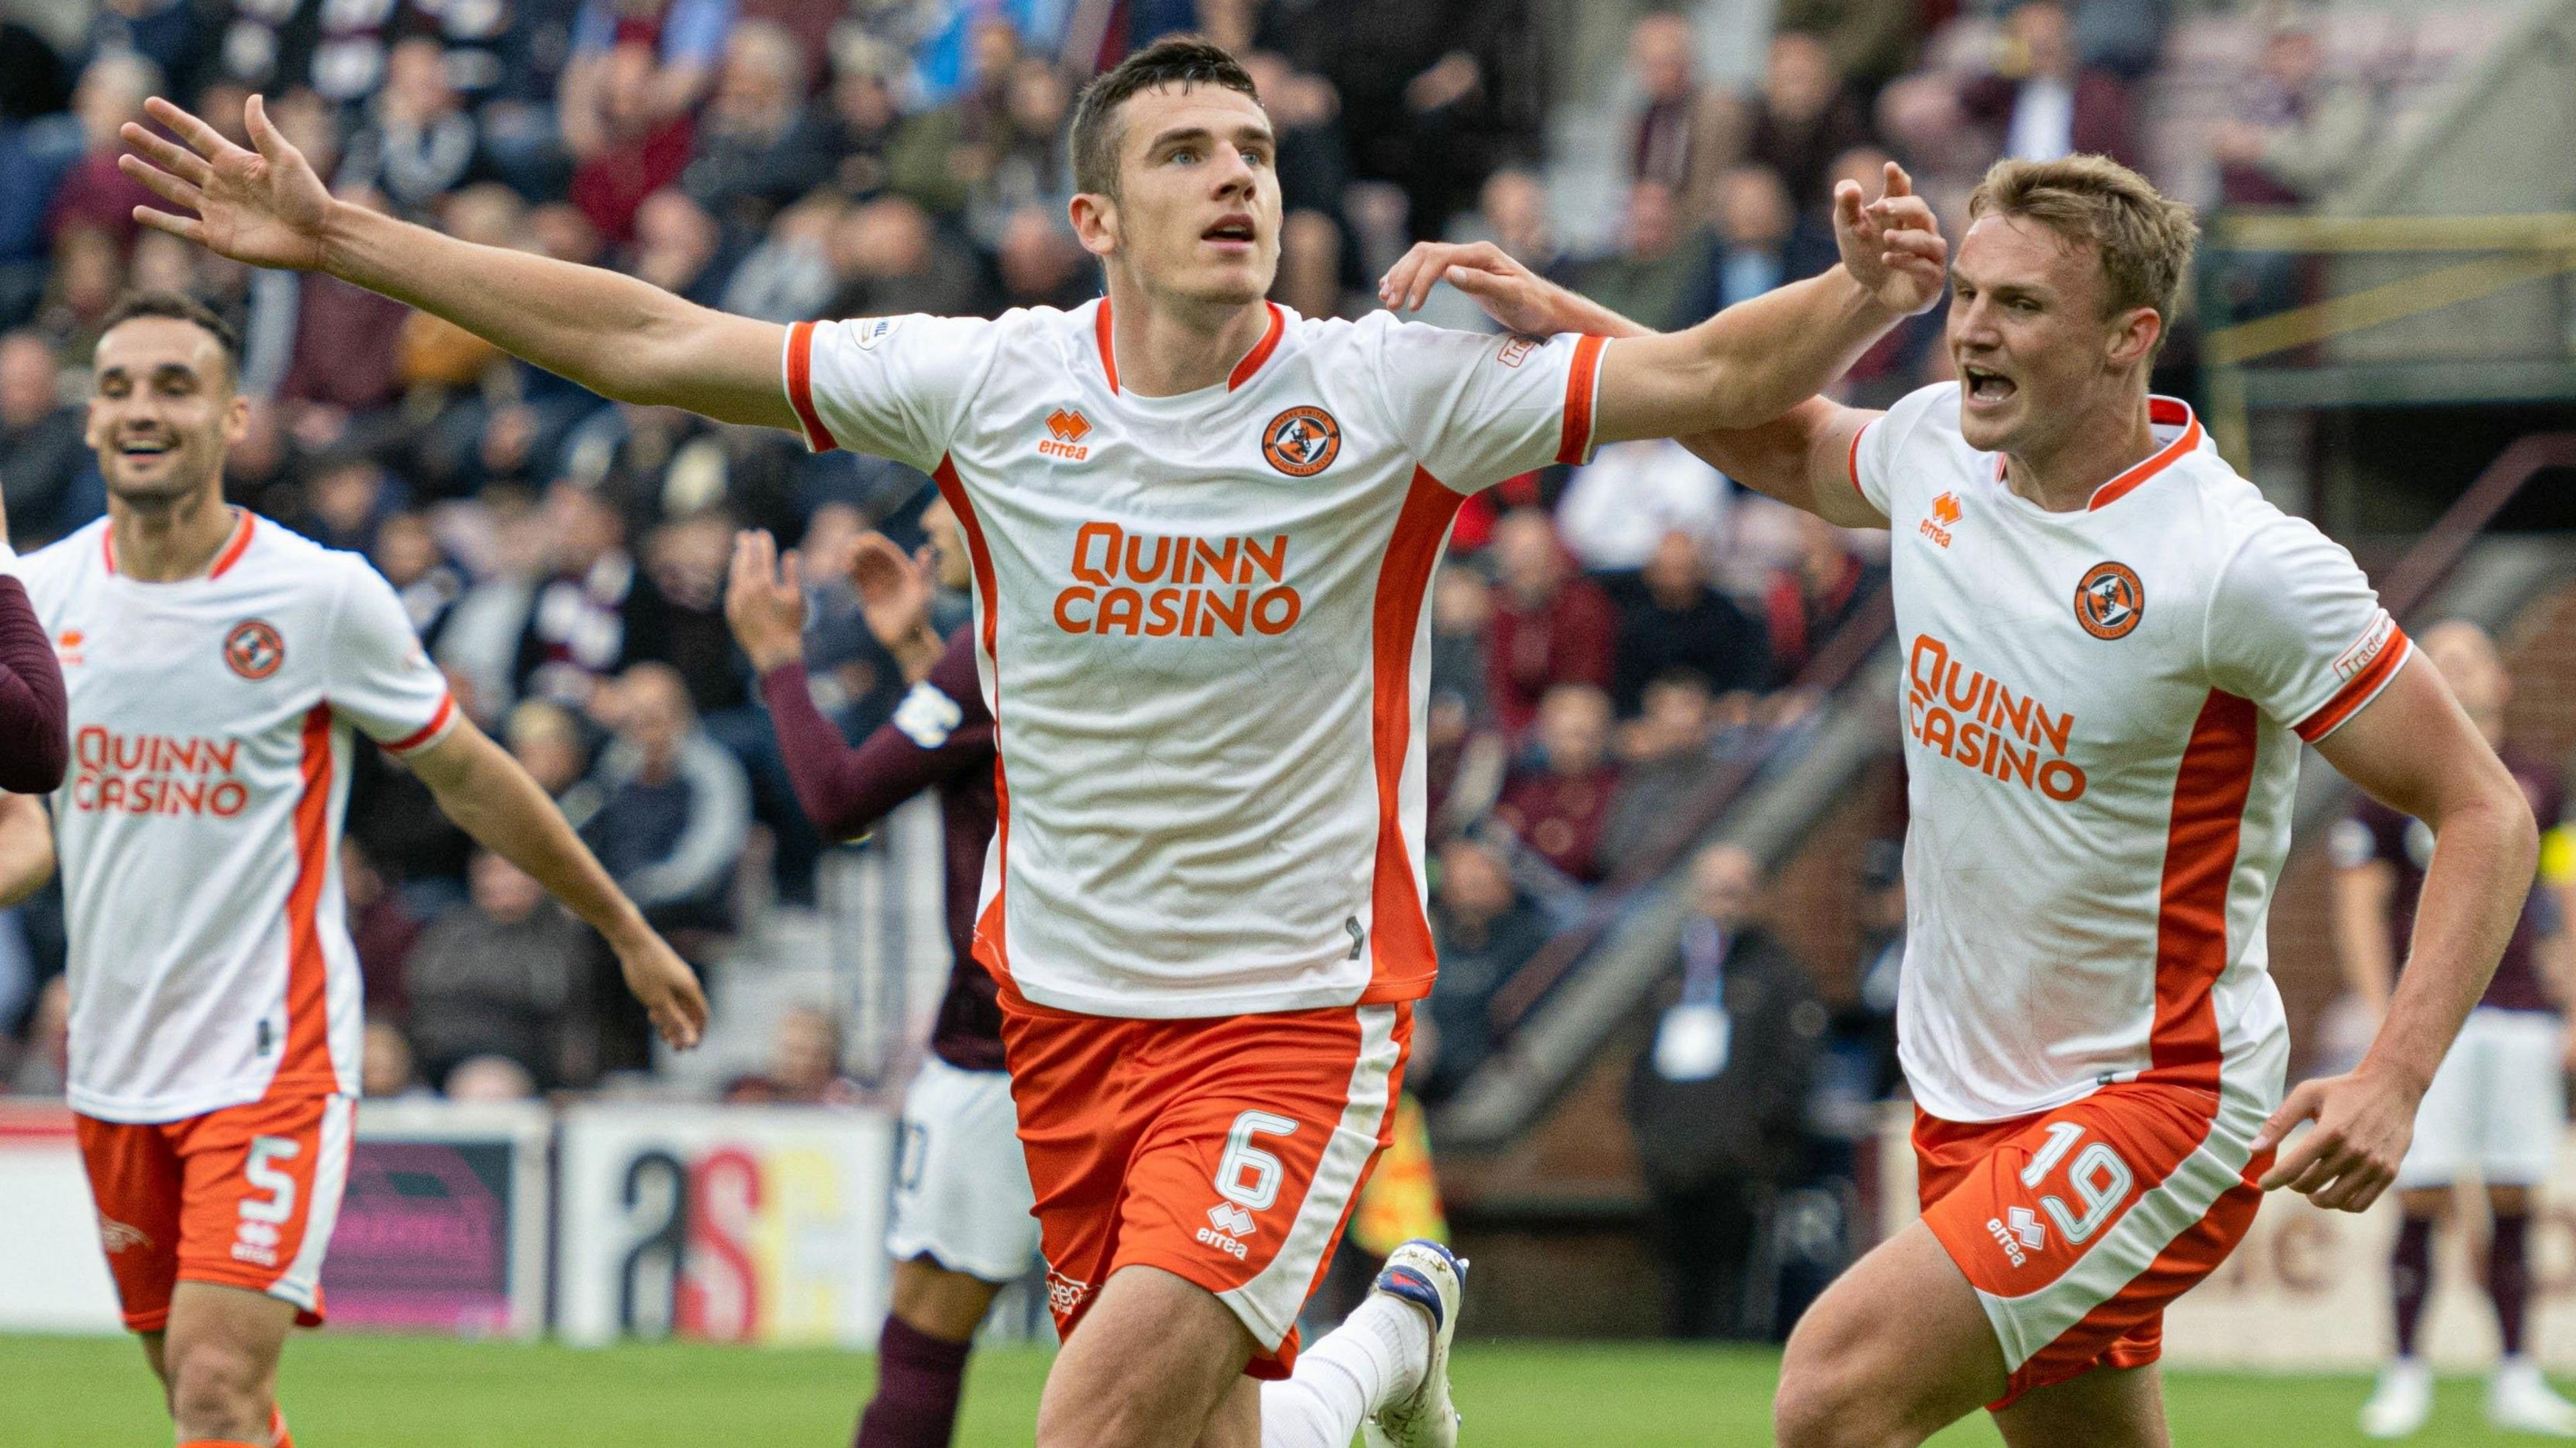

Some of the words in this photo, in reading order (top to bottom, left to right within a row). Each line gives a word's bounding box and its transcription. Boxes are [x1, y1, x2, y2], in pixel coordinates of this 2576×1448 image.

[1038, 440, 1087, 460] errea
[1071, 522, 1289, 586] QUINN
[1053, 586, 1302, 637] CASINO
[1910, 634, 2076, 757] QUINN
[76, 725, 239, 773] QUINN
[1909, 690, 2087, 802] CASINO
[76, 775, 249, 818] CASINO
[237, 1134, 301, 1224] 5
[1215, 1109, 1299, 1211] 6
[2021, 1121, 2135, 1245] 19
[1196, 1227, 1248, 1261] errea
[1986, 1218, 2027, 1268] errea
